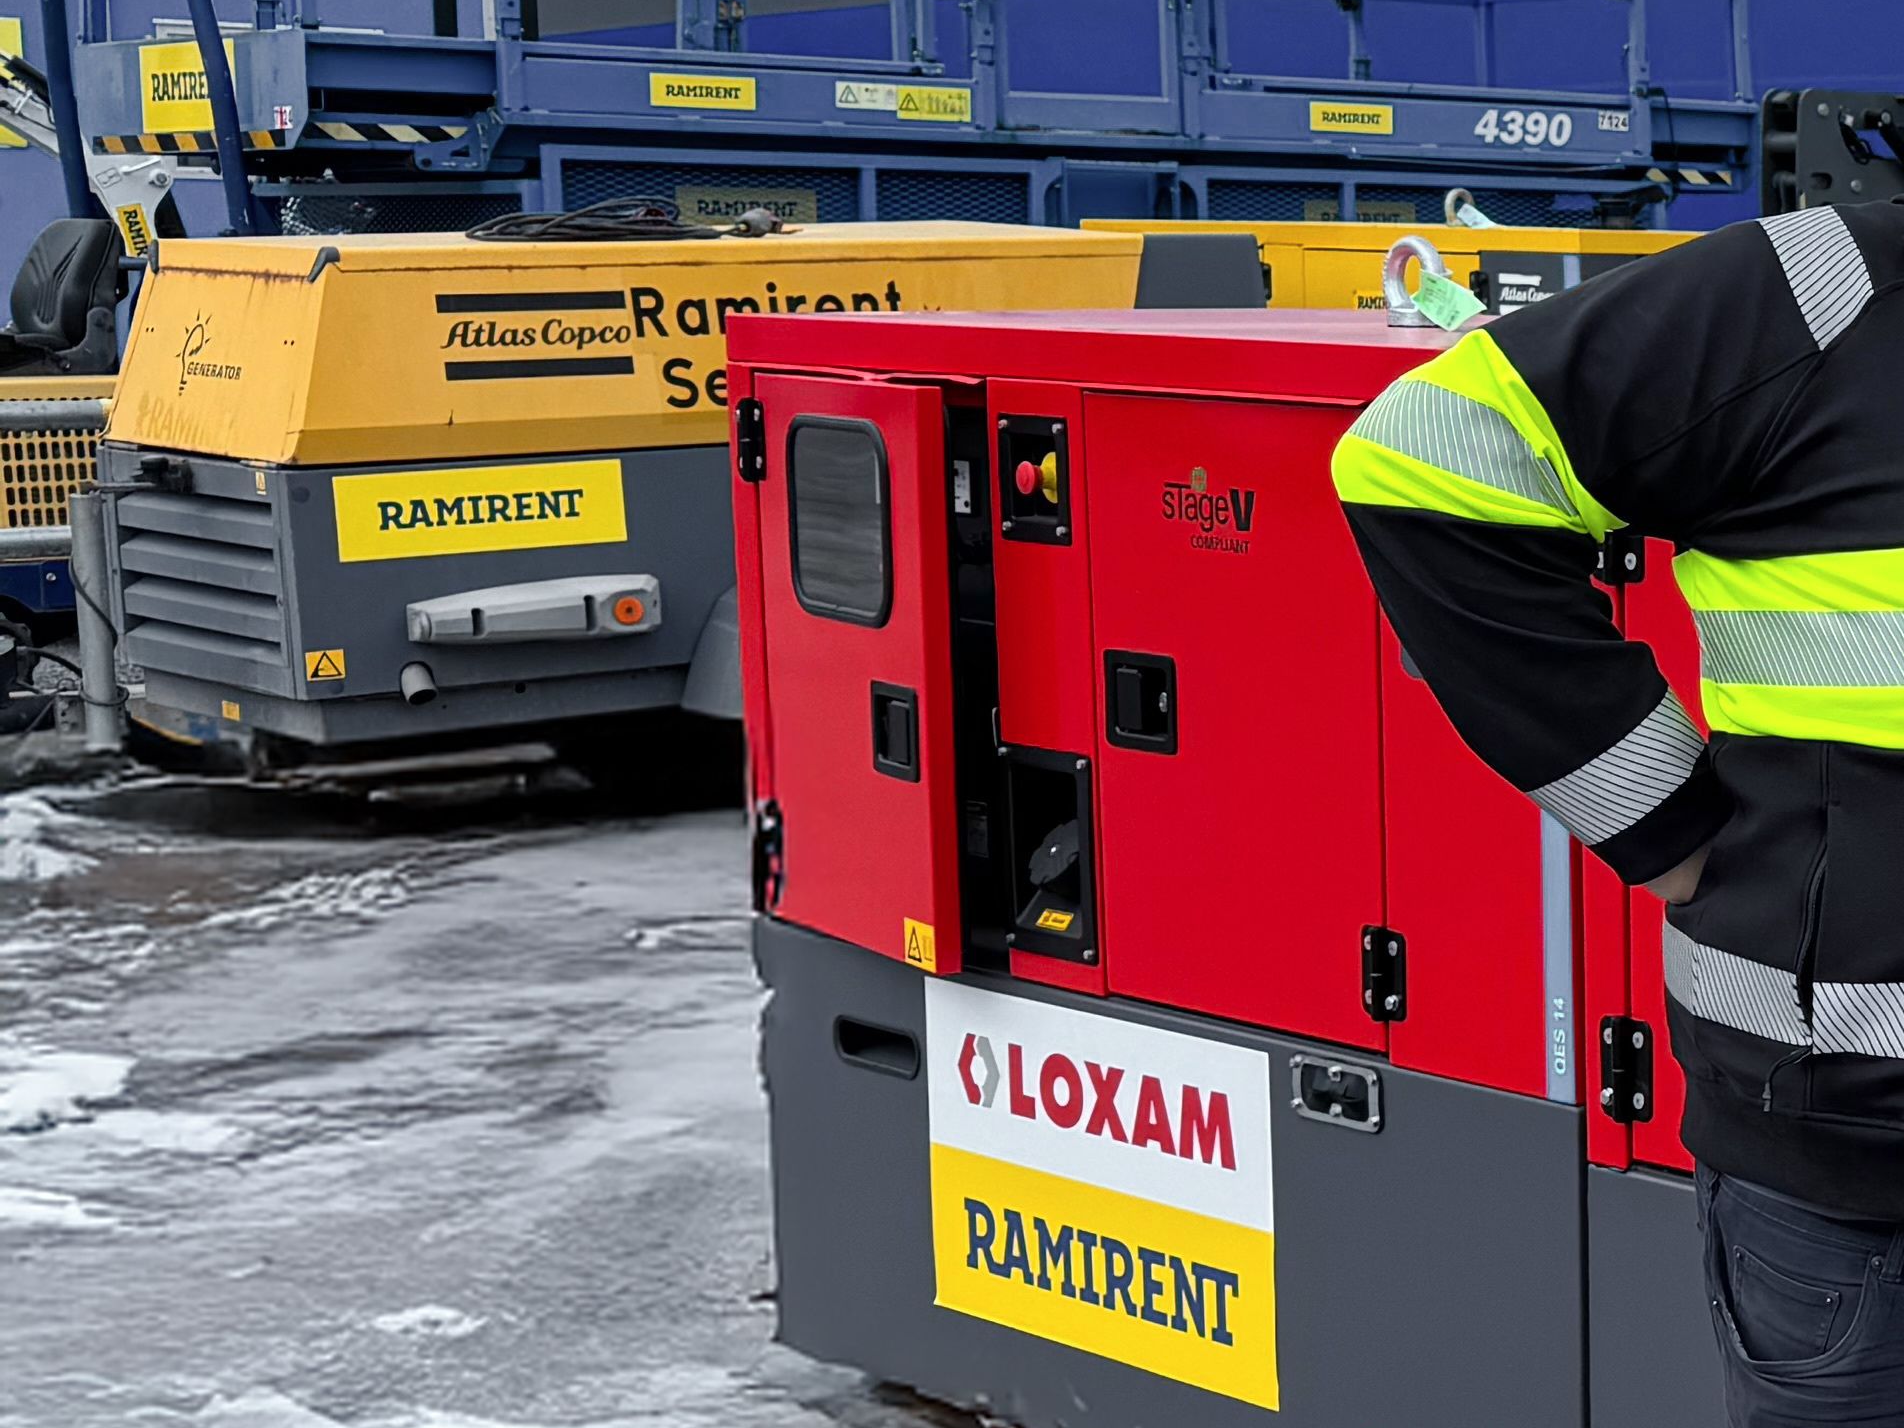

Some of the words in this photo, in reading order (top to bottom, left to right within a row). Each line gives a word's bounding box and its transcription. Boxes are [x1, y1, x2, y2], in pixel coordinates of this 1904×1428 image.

[151, 71, 209, 102] RAMIRE
[665, 84, 741, 100] RAMIRENT
[1321, 111, 1382, 125] RAMIRENT
[1473, 108, 1572, 147] 4390
[122, 209, 149, 257] RAMIR
[1499, 286, 1527, 302] Atlas
[441, 319, 537, 350] Atlas
[541, 318, 632, 350] Copco
[186, 362, 242, 381] GENERATOR
[377, 488, 583, 530] RAMIRENT
[1190, 535, 1250, 554] COMPLIANT
[1553, 998, 1565, 1021] 14
[1007, 1042, 1237, 1172] LOXAM
[963, 1196, 1239, 1348] RAMIRENT
